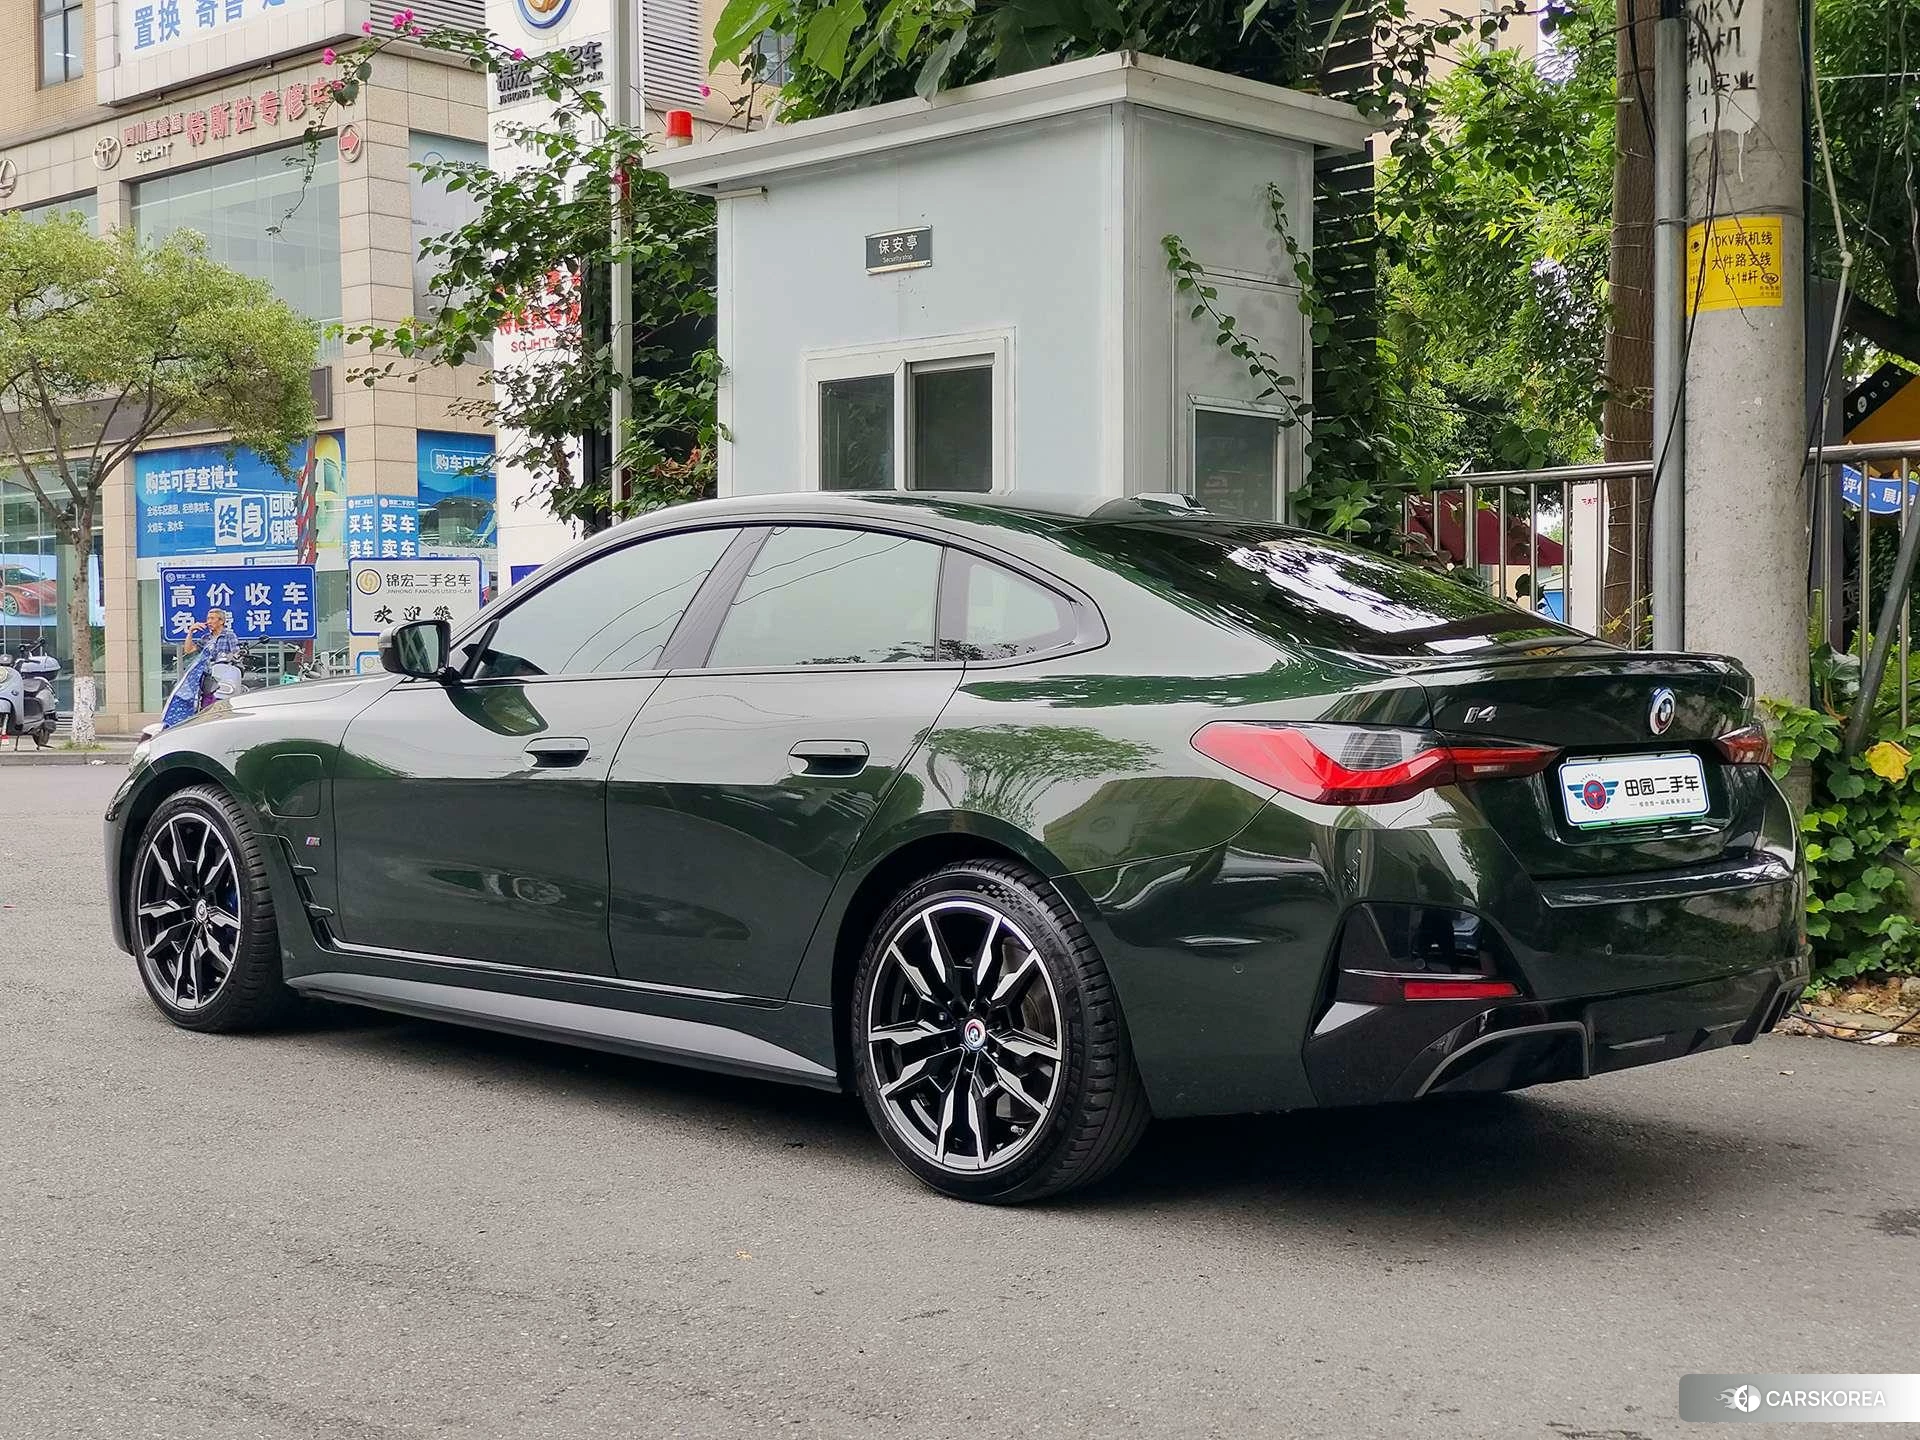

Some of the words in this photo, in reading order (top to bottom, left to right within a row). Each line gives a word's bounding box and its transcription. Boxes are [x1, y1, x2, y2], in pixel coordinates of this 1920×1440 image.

[878, 234, 918, 255] 保安亭
[145, 464, 238, 495] 购车可享查博士
[218, 502, 263, 540] 终身
[349, 513, 374, 534] 买车
[381, 514, 416, 533] 买车
[270, 520, 298, 545] 保障
[381, 539, 417, 557] 卖车
[386, 573, 472, 588] 锦宏二手名车
[169, 582, 309, 608] 高价收车
[1625, 775, 1700, 797] 田园二手车
